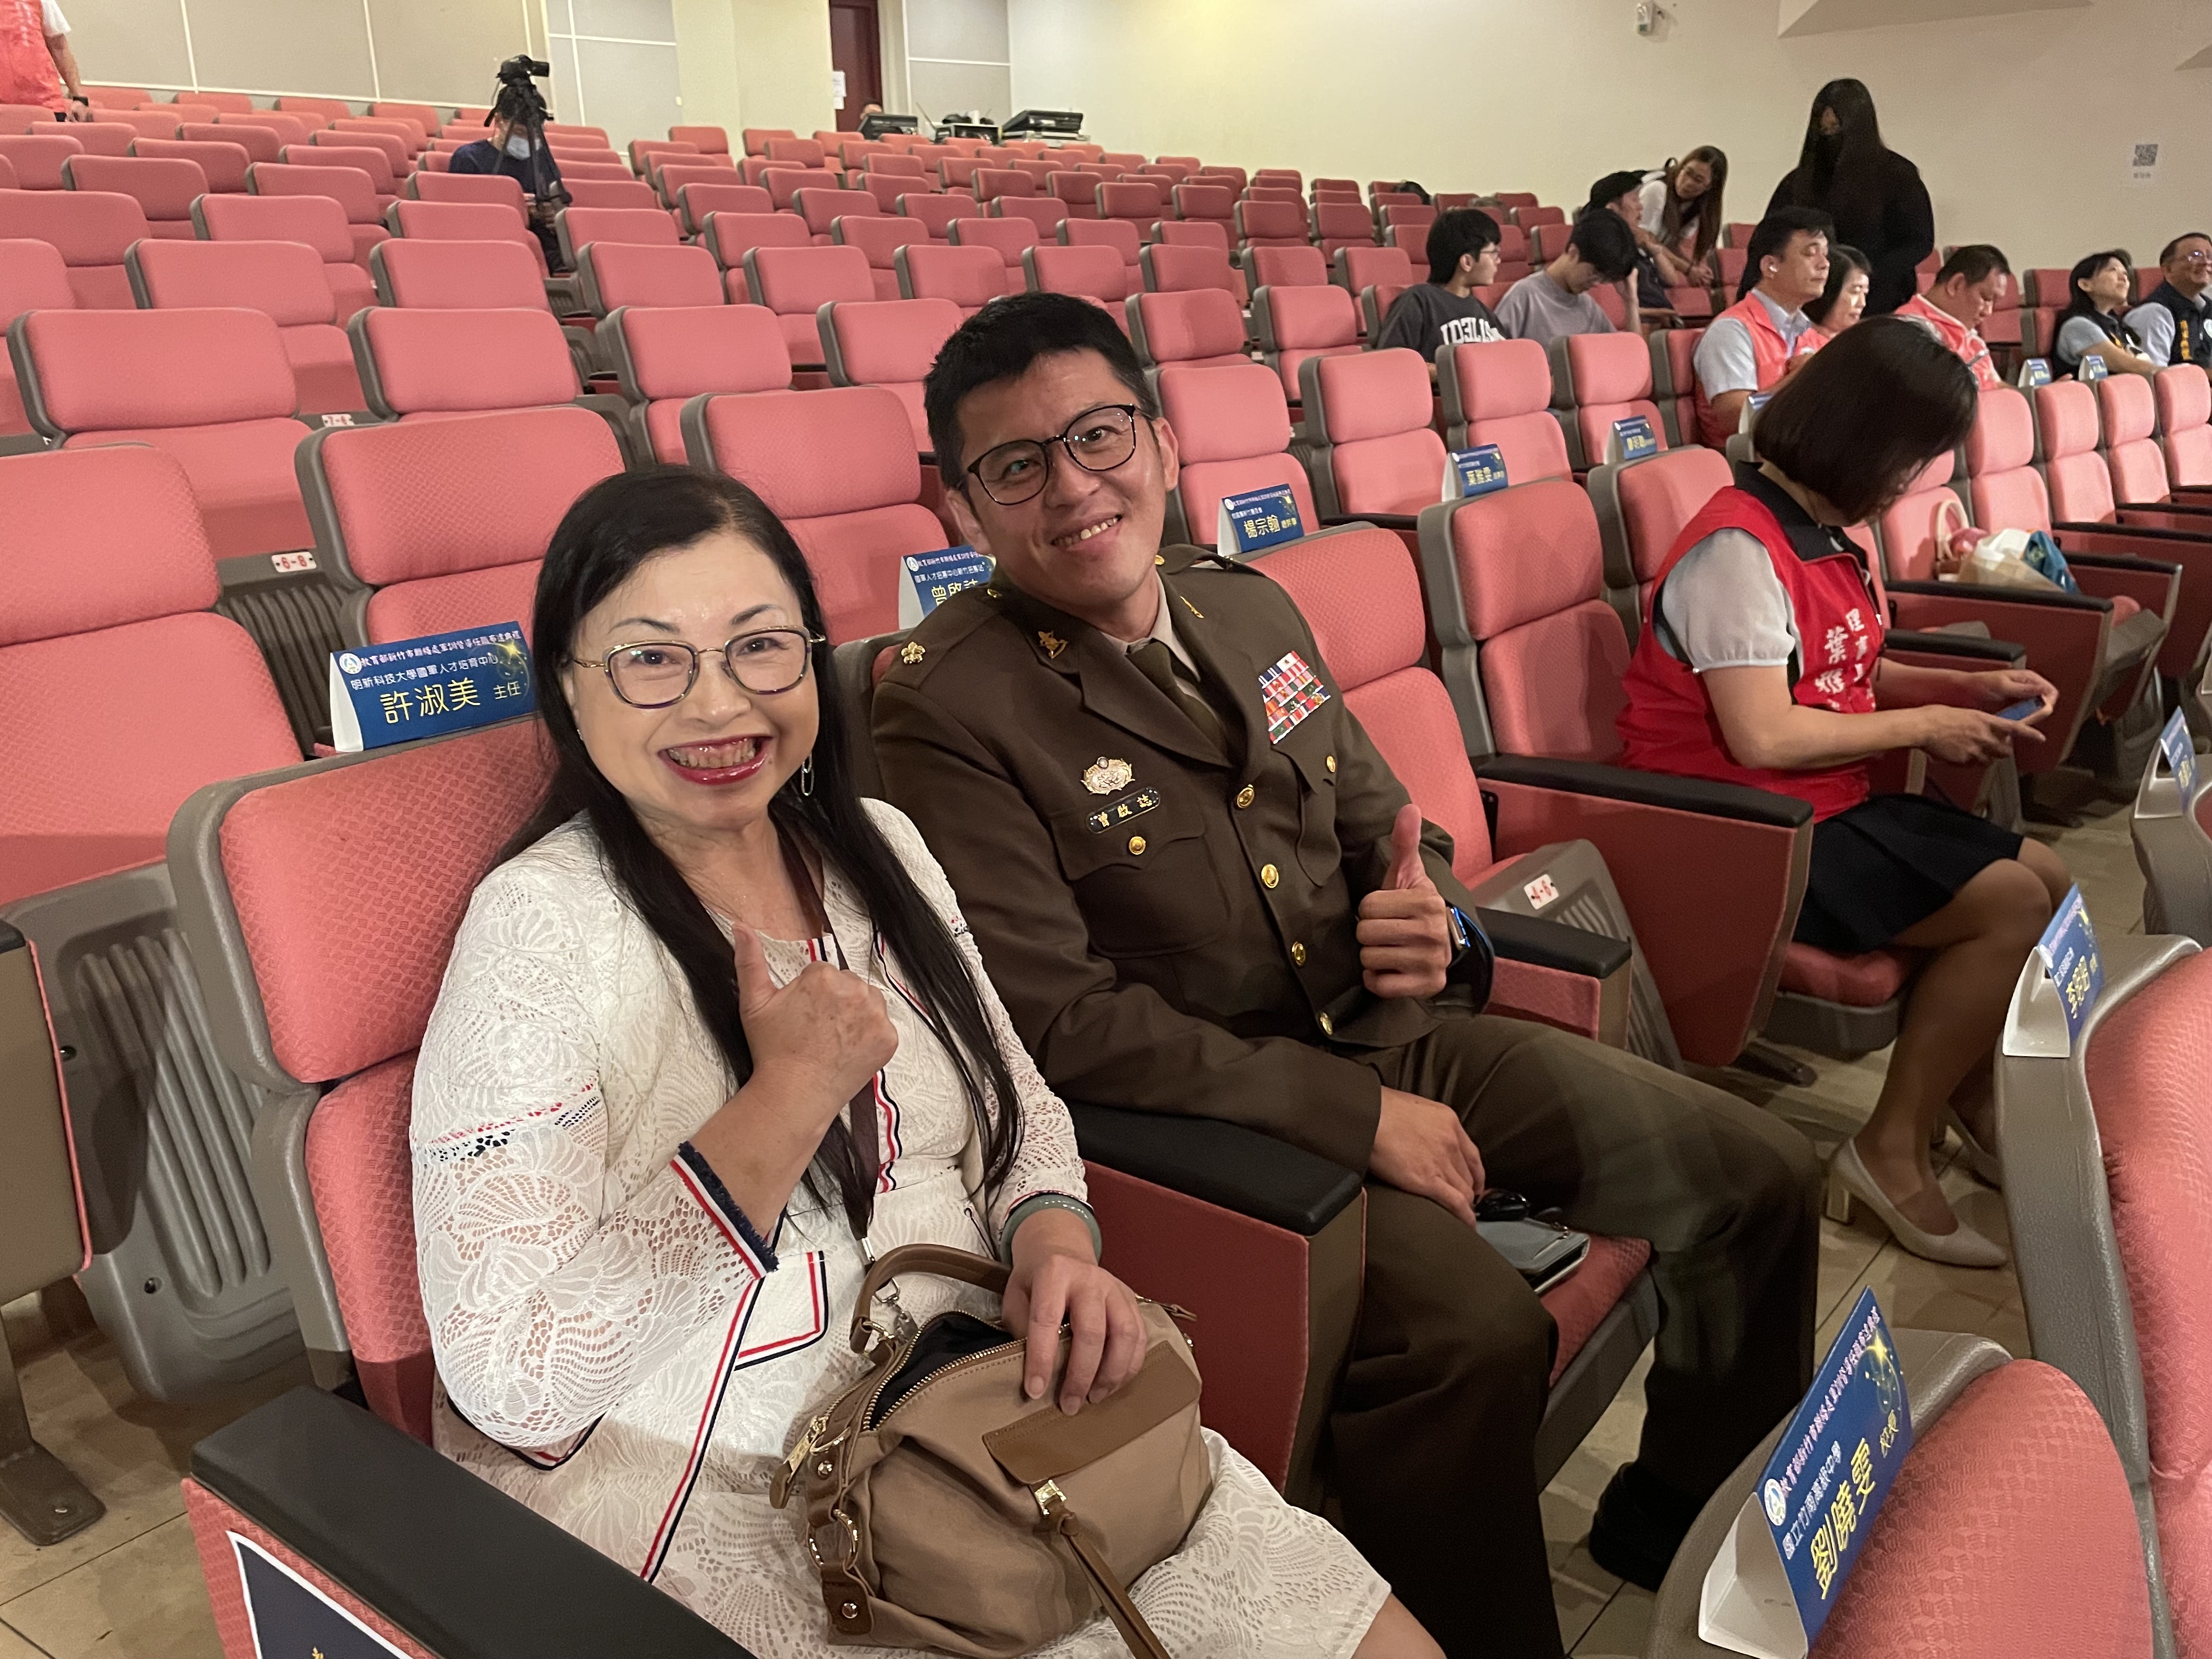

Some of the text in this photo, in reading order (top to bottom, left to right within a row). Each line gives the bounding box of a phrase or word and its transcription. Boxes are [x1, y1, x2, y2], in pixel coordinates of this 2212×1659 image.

[1244, 514, 1280, 538] 楊宗翰
[380, 676, 522, 724] 許淑美 主任
[1810, 1437, 1876, 1600] 劉曉雯
